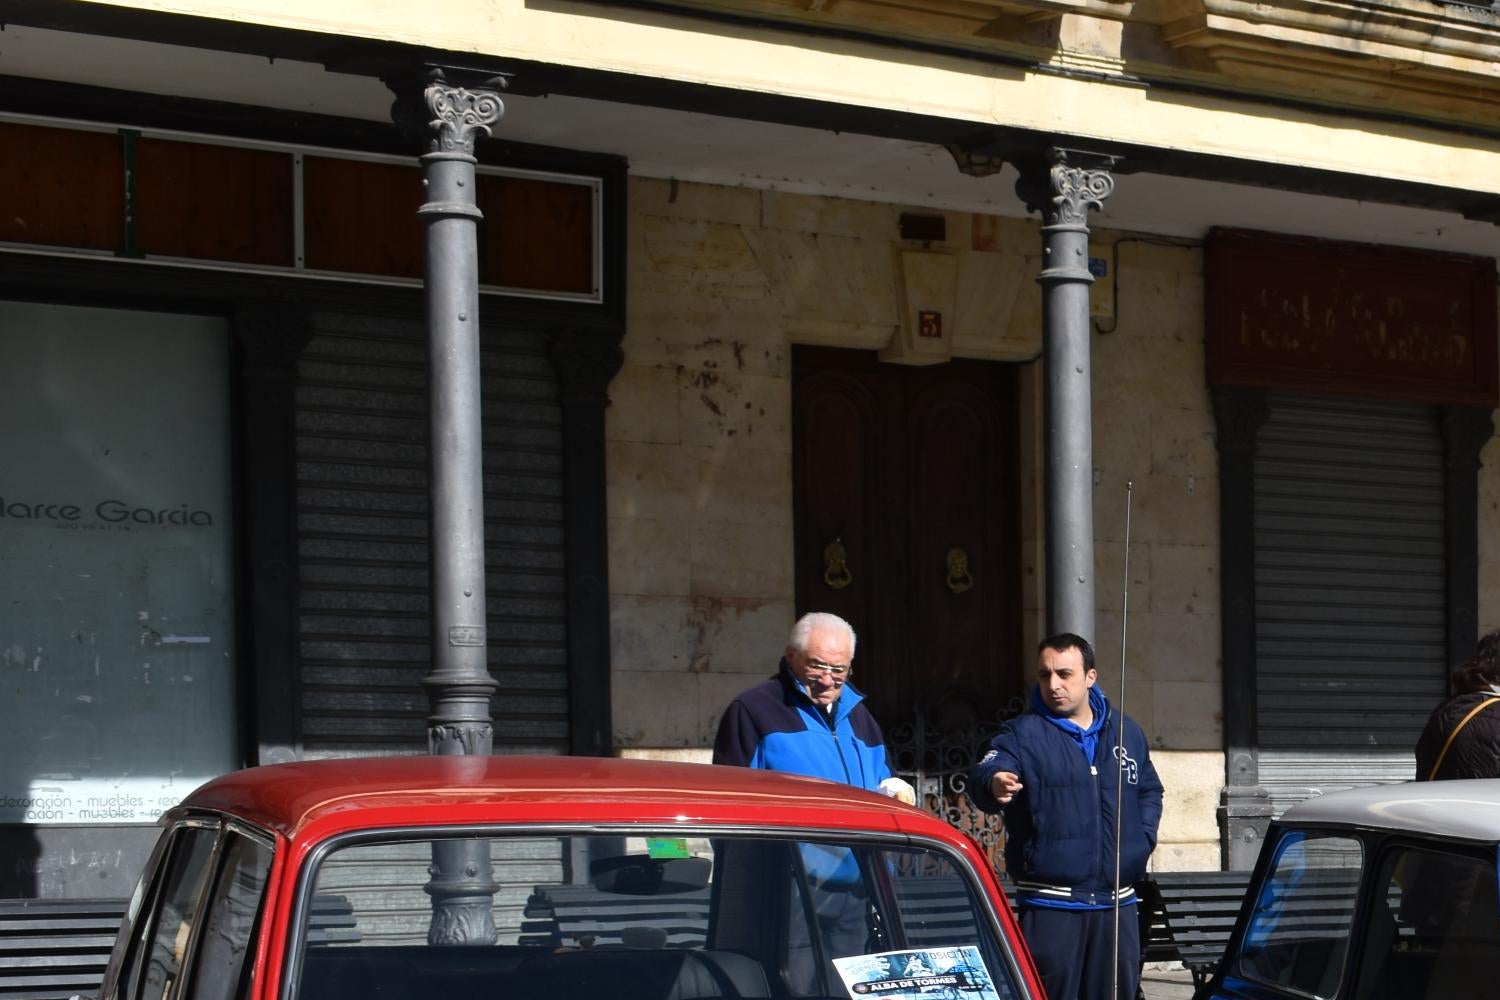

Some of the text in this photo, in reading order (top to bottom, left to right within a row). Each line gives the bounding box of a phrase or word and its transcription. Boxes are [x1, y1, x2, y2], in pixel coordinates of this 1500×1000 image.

[922, 313, 937, 336] 3
[0, 497, 81, 521] arce
[88, 794, 143, 807] muebles
[871, 977, 957, 991] ALBA DE TORMES
